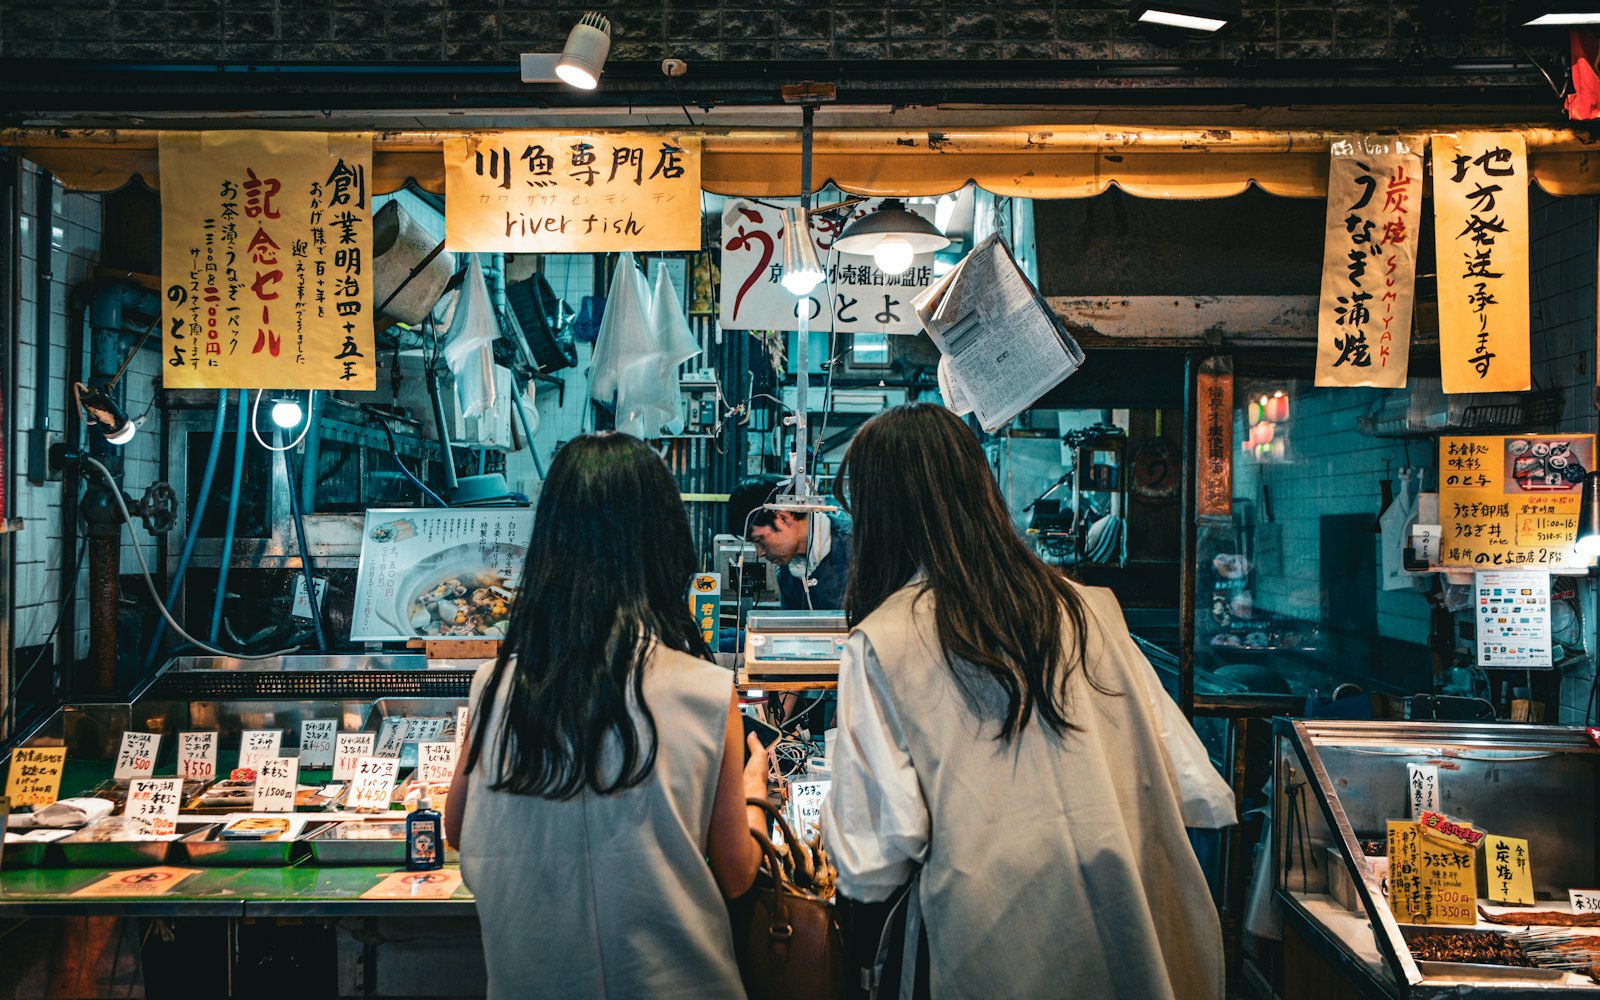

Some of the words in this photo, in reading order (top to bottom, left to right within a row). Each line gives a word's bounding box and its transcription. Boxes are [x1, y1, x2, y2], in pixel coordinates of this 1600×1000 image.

[475, 141, 685, 190] 川魚専門店
[652, 193, 675, 205] テン
[1380, 165, 1411, 246] 炭焼
[505, 211, 572, 238] river
[582, 211, 646, 236] fish
[310, 181, 327, 318] おかげ様で百十年を
[243, 167, 283, 358] 記念セール
[325, 158, 364, 381] 創業明治四十五年
[1332, 162, 1383, 368] うなぎ蒲焼
[1450, 146, 1515, 379] 地方発送承ります
[768, 263, 931, 288] 京小売組合加盟店
[291, 239, 308, 365] 迎える事ができました
[793, 293, 901, 324] のとよ
[1380, 254, 1397, 367] SUMIYAKI
[167, 284, 188, 367] のとよ
[1448, 441, 1489, 455] お食事処
[1448, 457, 1482, 470] 味彩
[1447, 474, 1491, 487] のと与
[1551, 496, 1575, 504] 水曜日
[1453, 502, 1510, 519] うなぎ御膳
[1520, 505, 1555, 514] 営業時間
[1455, 522, 1502, 538] うなぎ丼
[1537, 517, 1577, 529] 11:00~16:
[1448, 548, 1473, 561] 場所
[424, 745, 451, 755] すっぽん
[184, 759, 212, 777] ¥550
[361, 761, 393, 777] えび豆
[137, 781, 174, 792] びわ湖
[356, 786, 387, 801] ¥450
[1440, 821, 1483, 844] 売れてます!
[1423, 851, 1471, 870] うなぎのキモ
[1435, 887, 1469, 903] 500円
